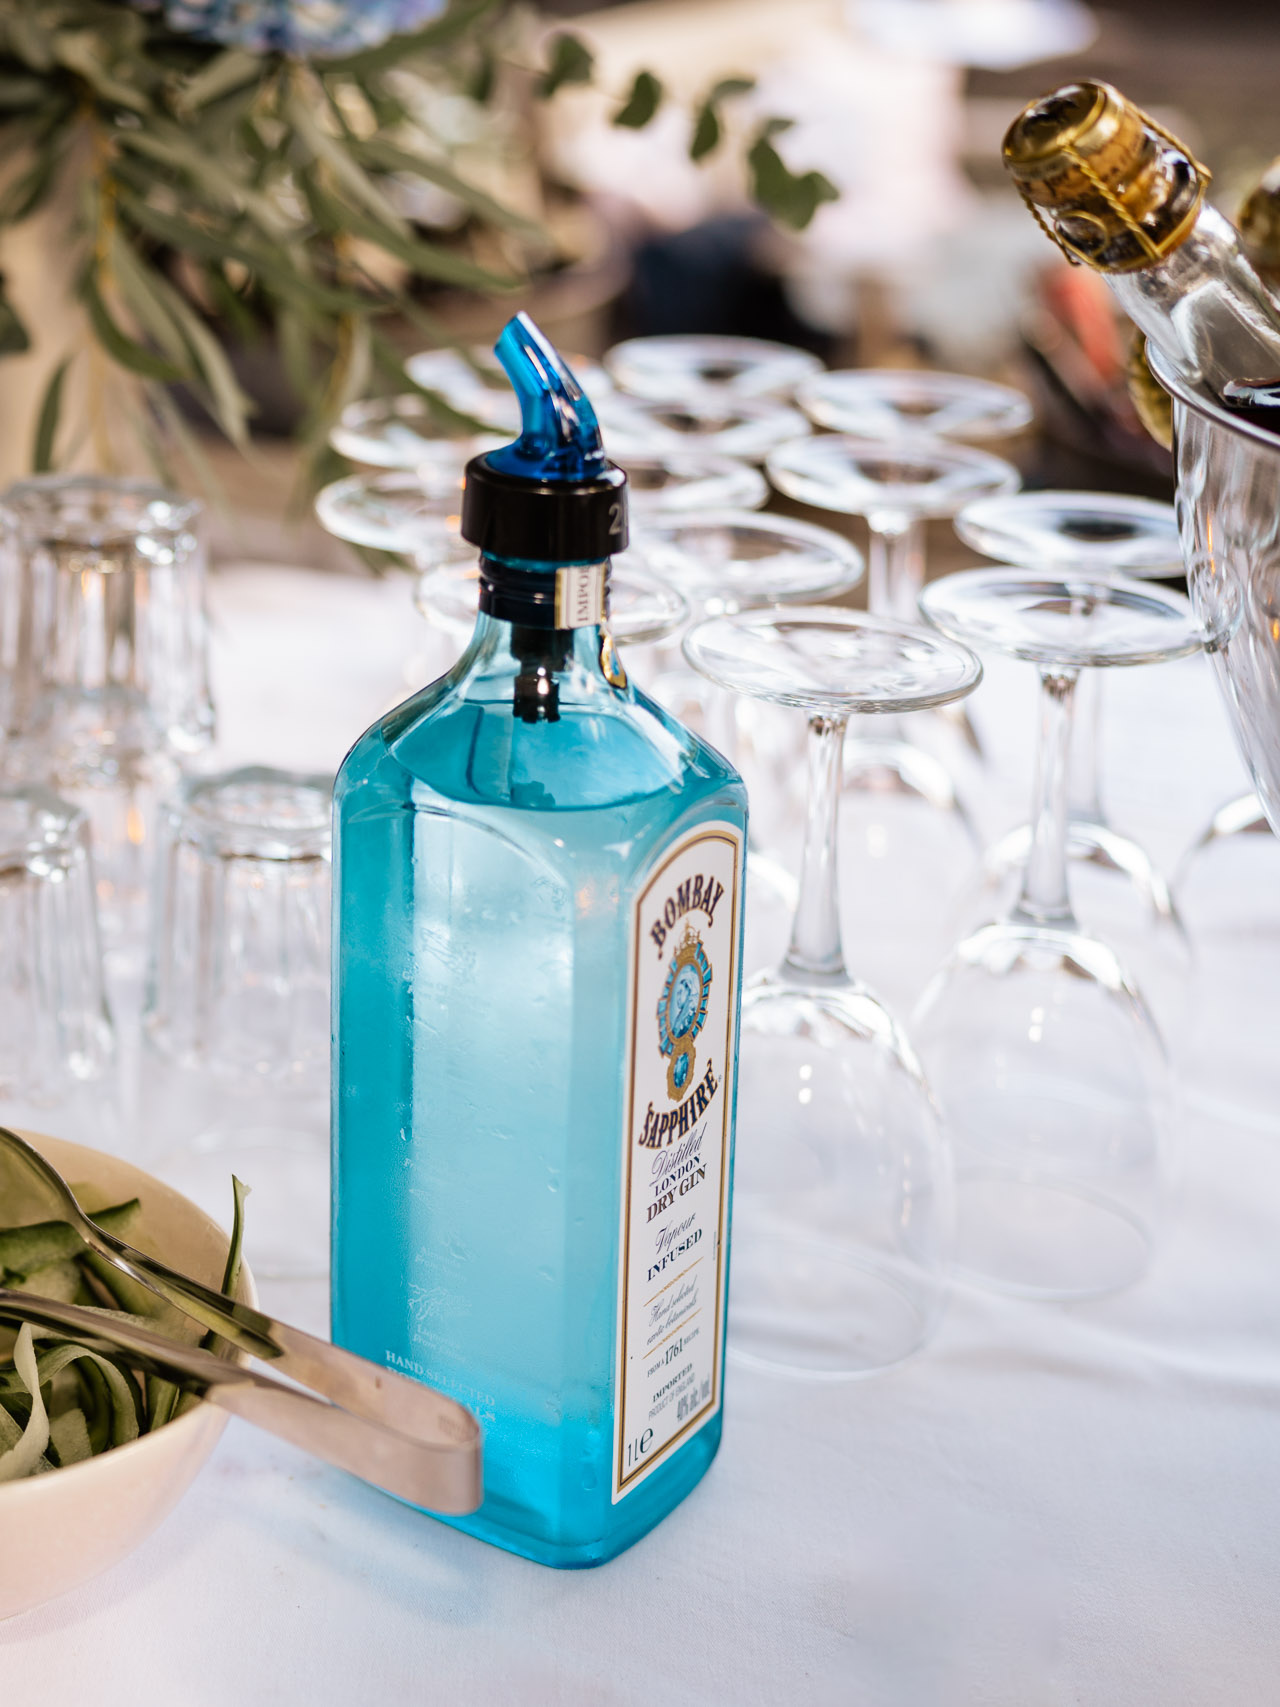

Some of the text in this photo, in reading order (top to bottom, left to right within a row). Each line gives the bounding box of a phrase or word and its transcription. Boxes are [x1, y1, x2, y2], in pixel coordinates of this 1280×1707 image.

[650, 873, 724, 961] BOMBAY
[639, 1057, 718, 1149] SAPPHIRE
[649, 1121, 707, 1188] Distilled
[654, 1153, 701, 1197] LONDON
[646, 1162, 707, 1224] DRY GIN
[646, 1227, 702, 1282] INFUSED
[385, 1349, 424, 1376] HAND
[665, 1337, 684, 1366] 1761
[652, 1362, 694, 1402] IMPORTED
